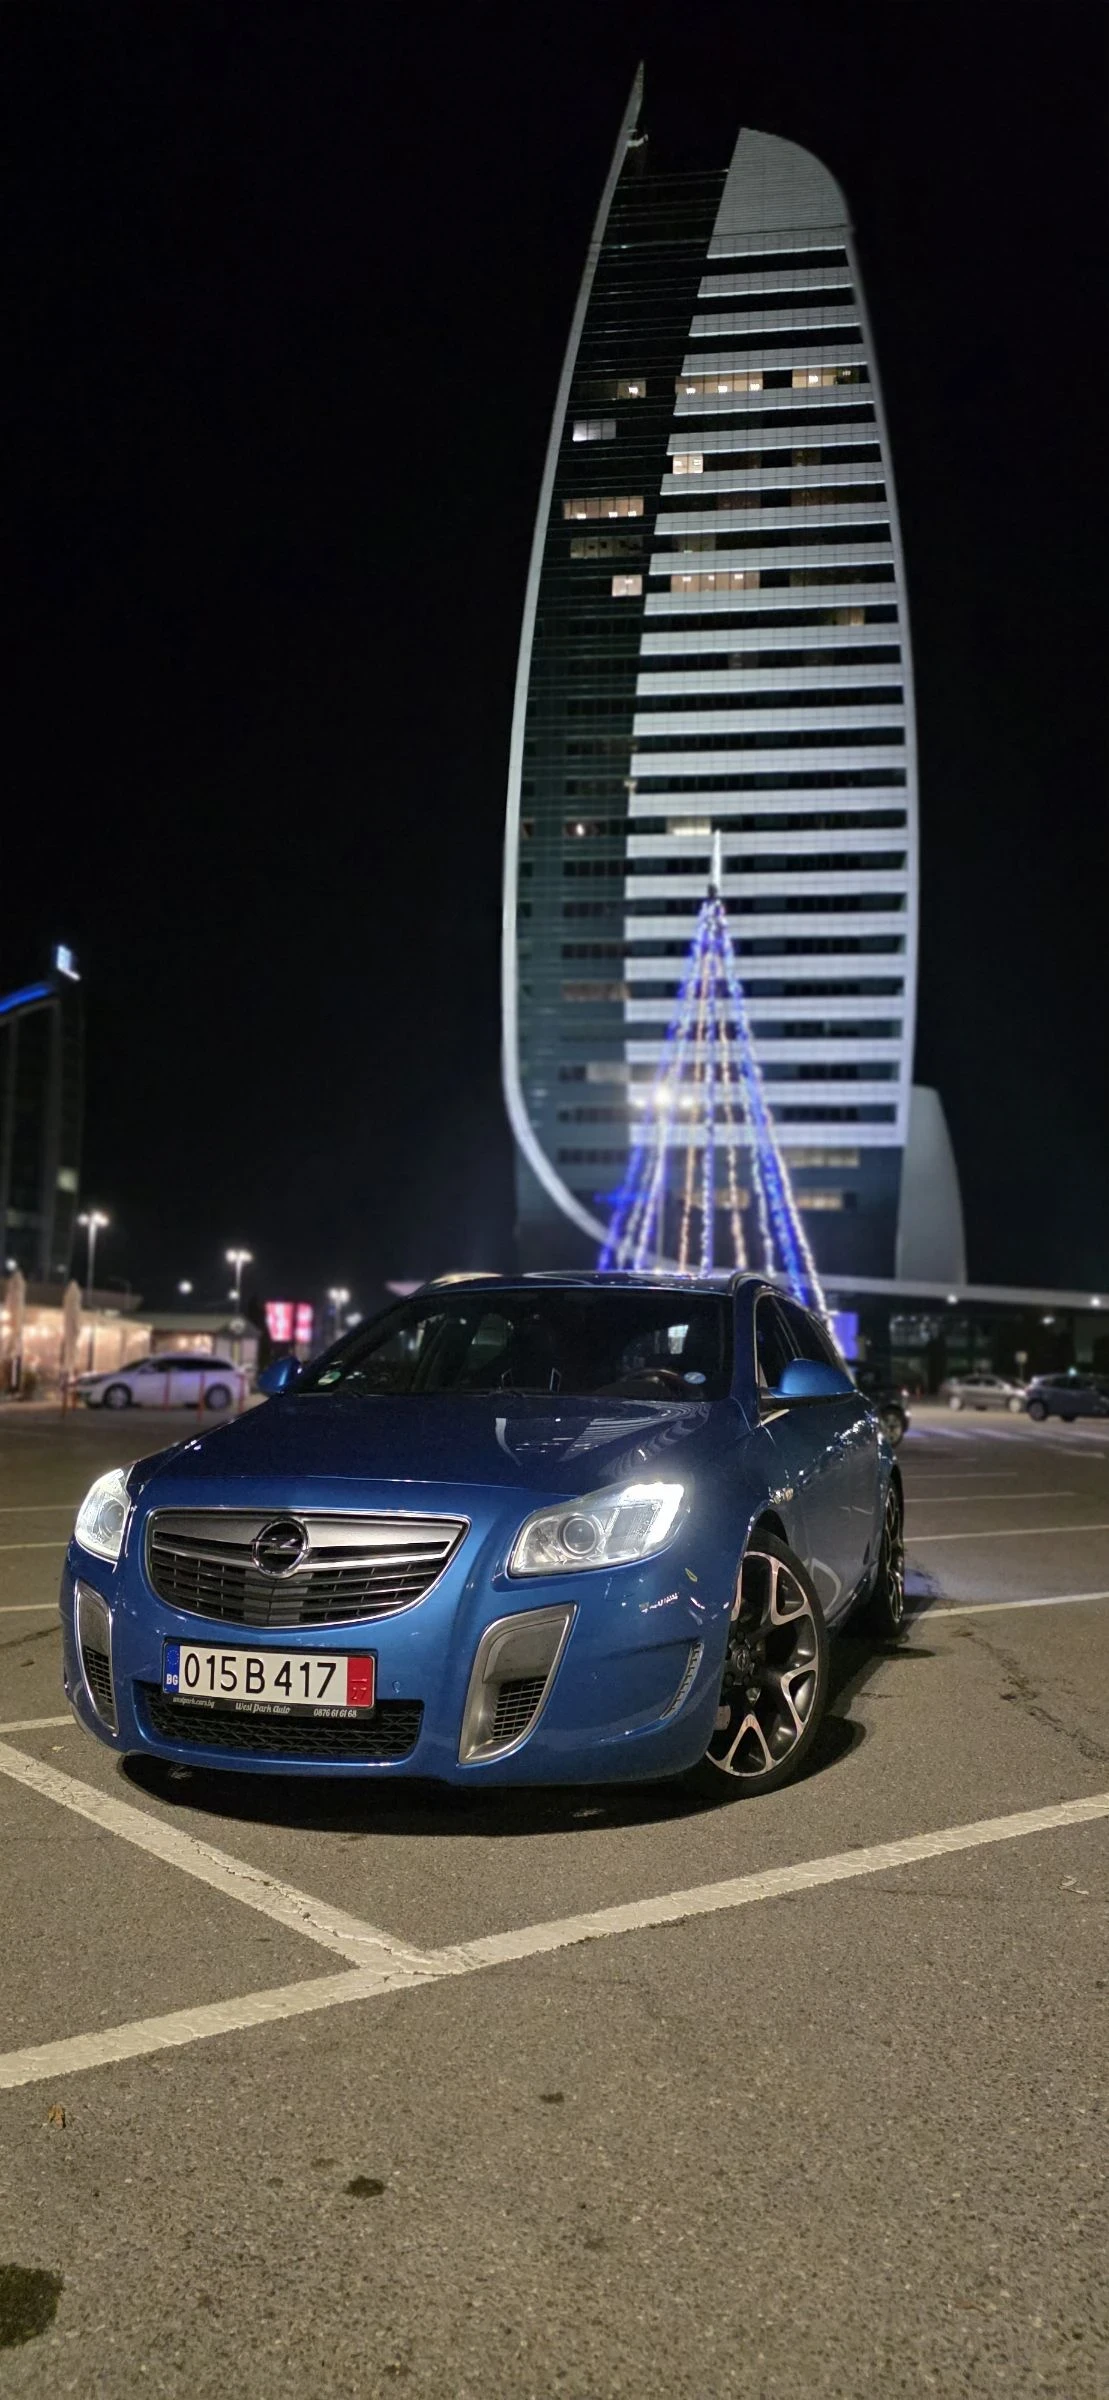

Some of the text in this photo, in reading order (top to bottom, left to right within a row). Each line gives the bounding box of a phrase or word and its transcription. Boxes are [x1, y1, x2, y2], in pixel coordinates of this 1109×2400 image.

[166, 1673, 179, 1686] BG
[235, 1702, 252, 1712] West
[252, 1703, 272, 1714] Park
[313, 1708, 330, 1718] 0876
